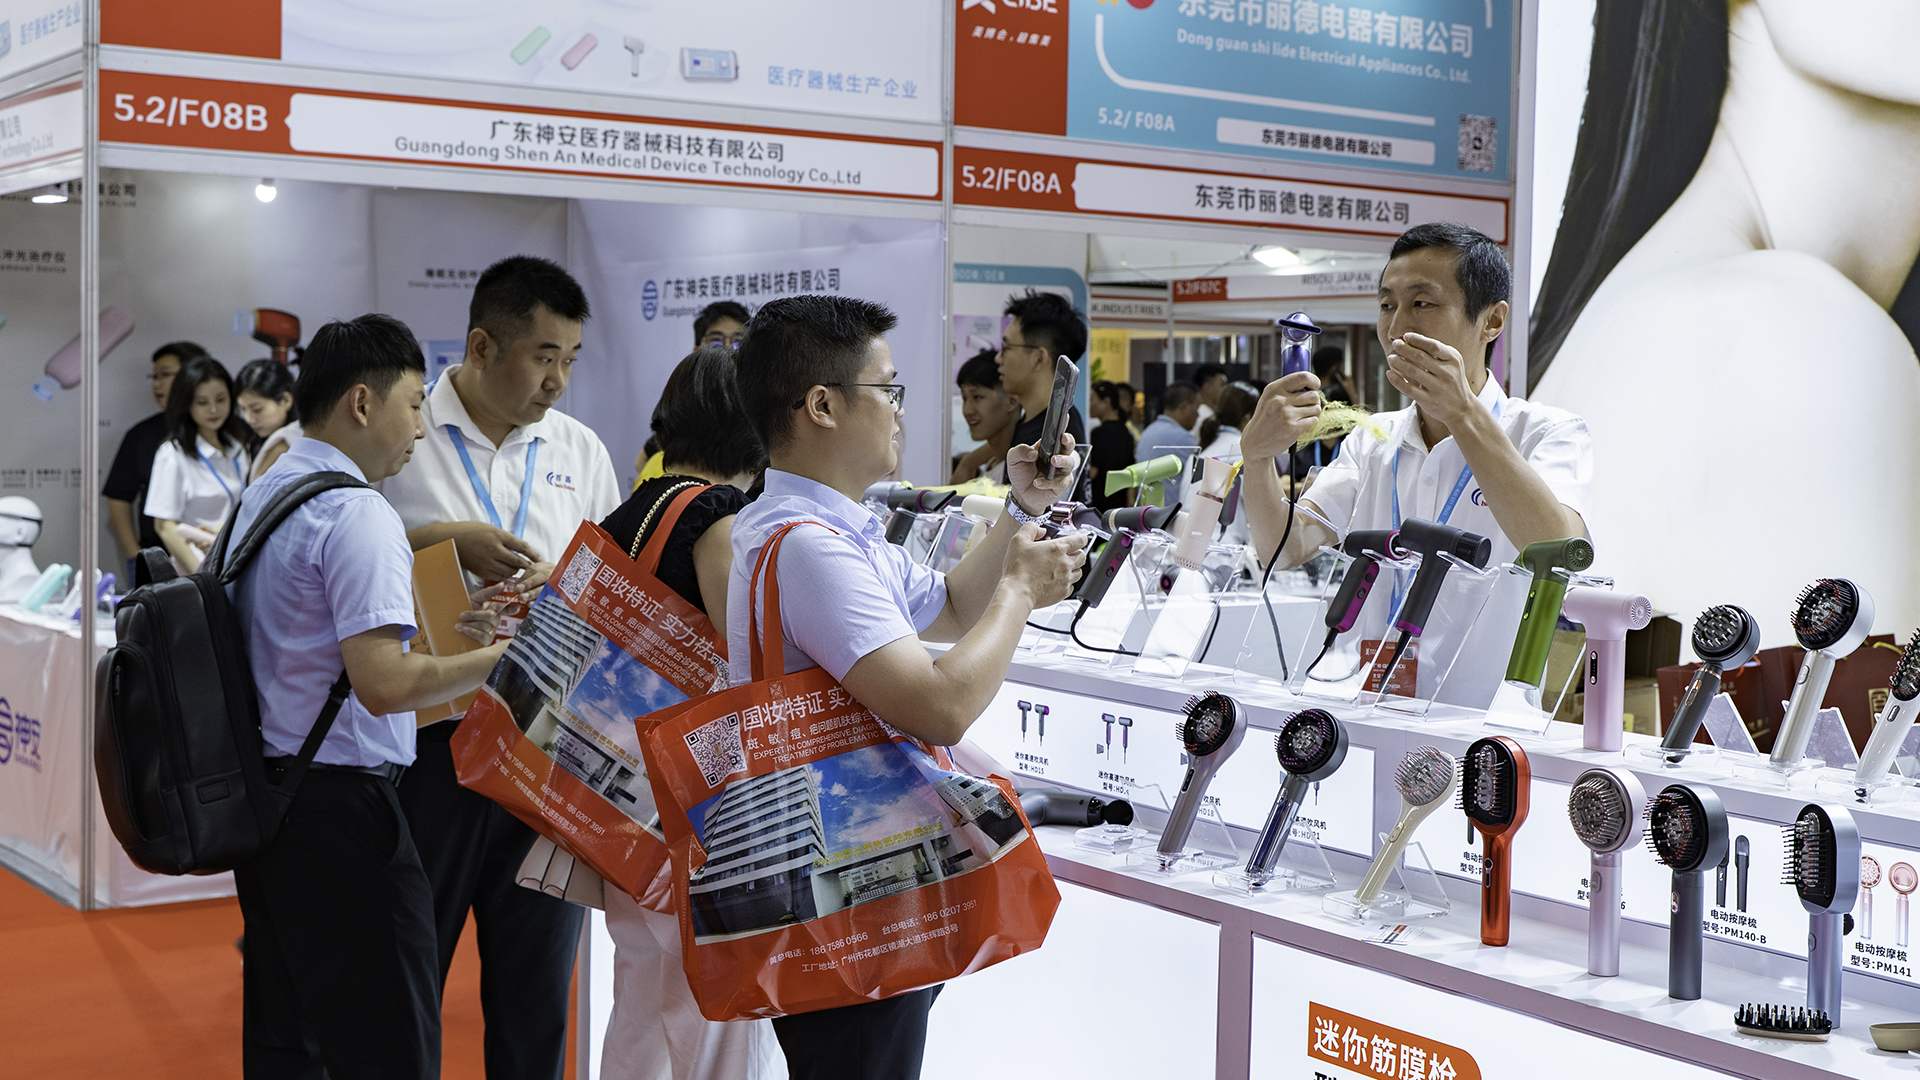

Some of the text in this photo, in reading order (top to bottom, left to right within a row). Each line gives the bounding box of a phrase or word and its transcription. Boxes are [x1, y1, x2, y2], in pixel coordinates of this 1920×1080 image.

[1176, 28, 1214, 50] Dong
[1215, 37, 1249, 52] guan
[1251, 40, 1271, 54] shi
[1272, 42, 1297, 59] lide
[1299, 46, 1357, 67] Electrical
[1357, 54, 1424, 78] Appliances
[1449, 68, 1472, 83] Ltd.
[767, 64, 918, 100] 医疗器械生产企业
[113, 93, 269, 133] 5.2/F08B
[1135, 111, 1176, 133] F08A
[394, 136, 499, 161] Guangdong
[504, 145, 549, 162] Shen
[554, 149, 576, 164] An
[581, 151, 647, 170] Medical
[651, 156, 708, 173] Device
[713, 161, 805, 184] Technology
[490, 120, 785, 163] 广东神安医疗器械科技有限公司
[1261, 128, 1393, 157] 东莞市丽德电器有限公司
[961, 165, 1063, 195] 5.2/F08A
[1194, 183, 1410, 226] 东莞市丽德电器有限公司
[662, 268, 840, 299] 广东神安医疗器械科技有限公司
[594, 564, 664, 622] 国妆特证
[582, 597, 705, 689] EXPERT IN COMPREHENSIVE DIAGNOSIS AND
[589, 611, 688, 686] TREATMENT OF PROBLEMATIC SKIN
[741, 690, 826, 732] 国妆特证
[753, 746, 785, 760] EXPERT
[786, 743, 796, 752] IN
[796, 729, 851, 749] COMPREHENSIVE
[852, 723, 879, 734] DIAGN
[772, 747, 818, 764] TREATMENT
[818, 745, 827, 753] OF
[827, 733, 877, 751] PROBLEMATIC
[810, 945, 826, 956] 186
[826, 938, 845, 952] 7586
[845, 931, 869, 946] 0566
[922, 911, 939, 923] 186
[939, 904, 961, 918] 0207
[962, 899, 978, 912] 3951
[1702, 920, 1767, 944] 型号:PM140-B
[1710, 908, 1758, 929] 电动按摩梳
[1850, 954, 1912, 978] 型号:PM141
[1855, 941, 1908, 962] 电动按摩梳
[1313, 1016, 1458, 1080] 迷你筋膜枪
